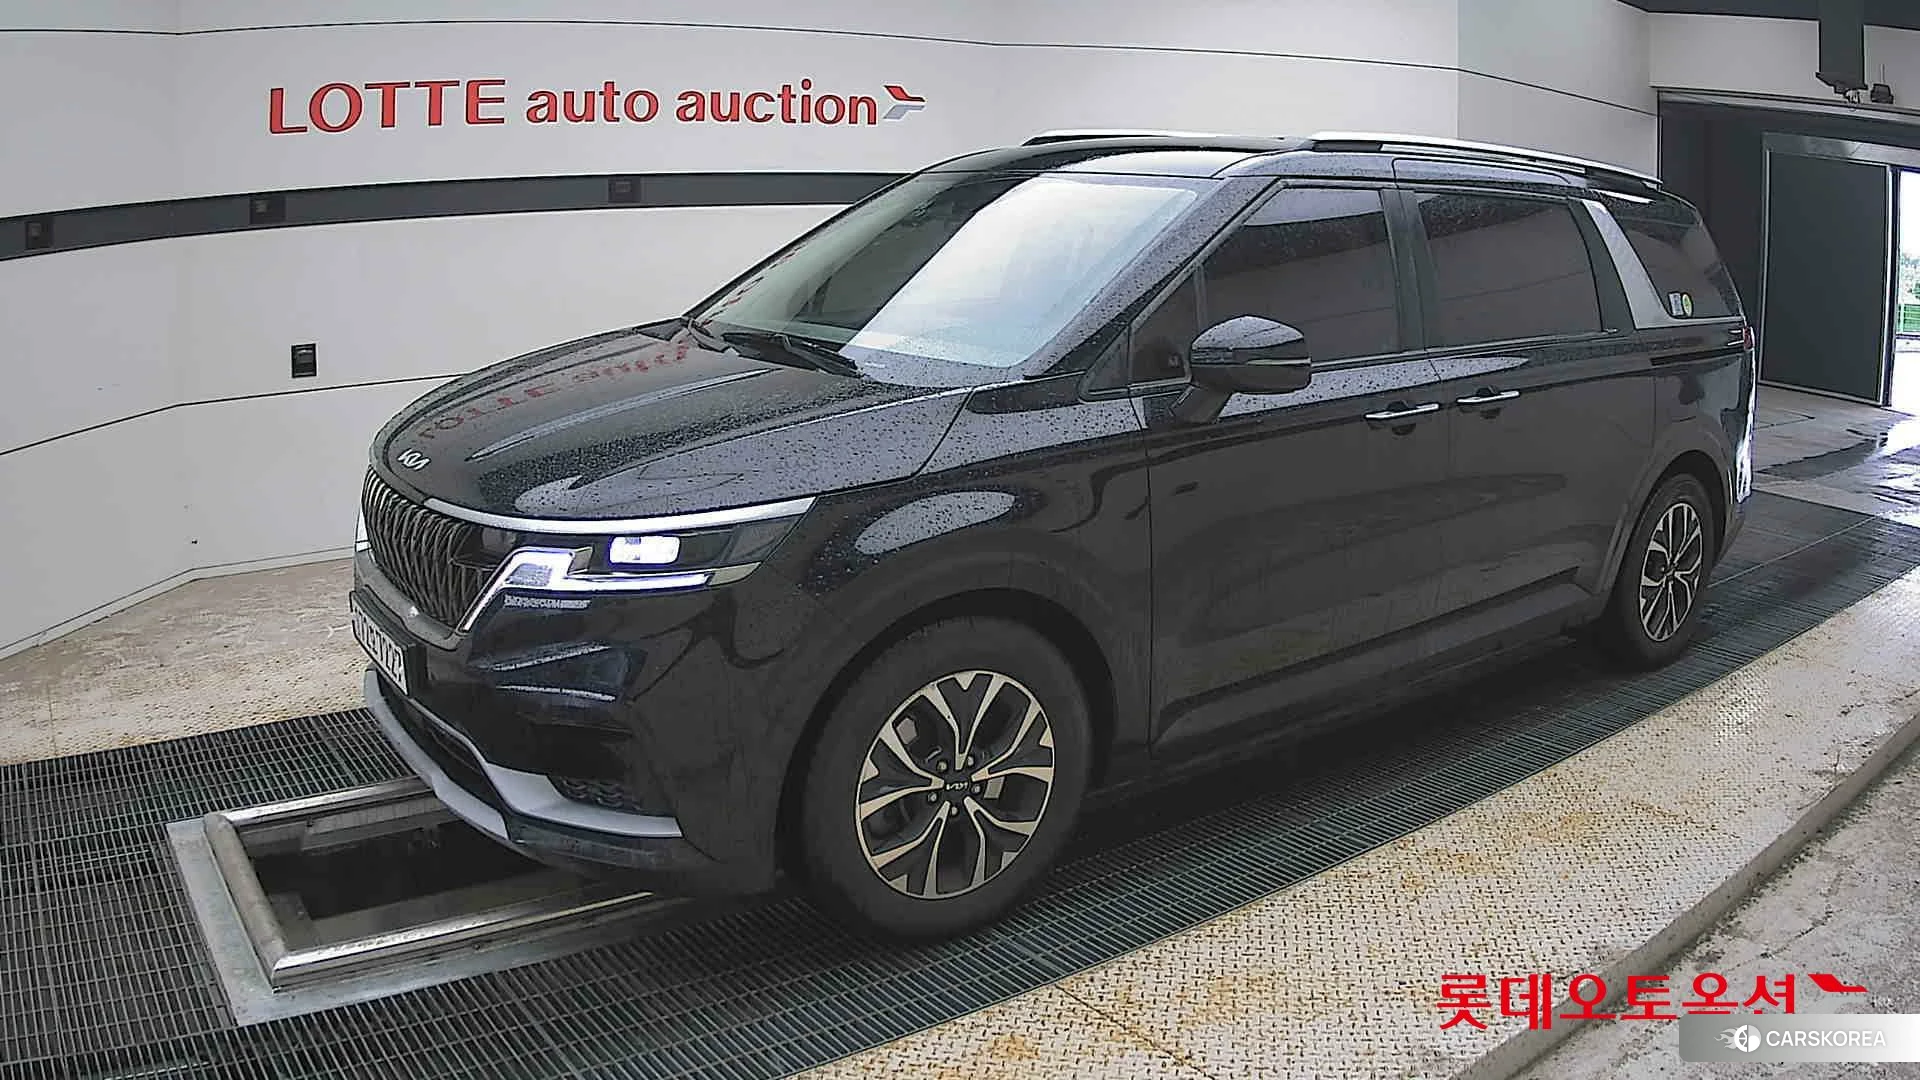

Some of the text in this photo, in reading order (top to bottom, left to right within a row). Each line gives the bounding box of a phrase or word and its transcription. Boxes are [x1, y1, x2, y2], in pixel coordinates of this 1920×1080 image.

[269, 77, 878, 134] LOTTE auto auction
